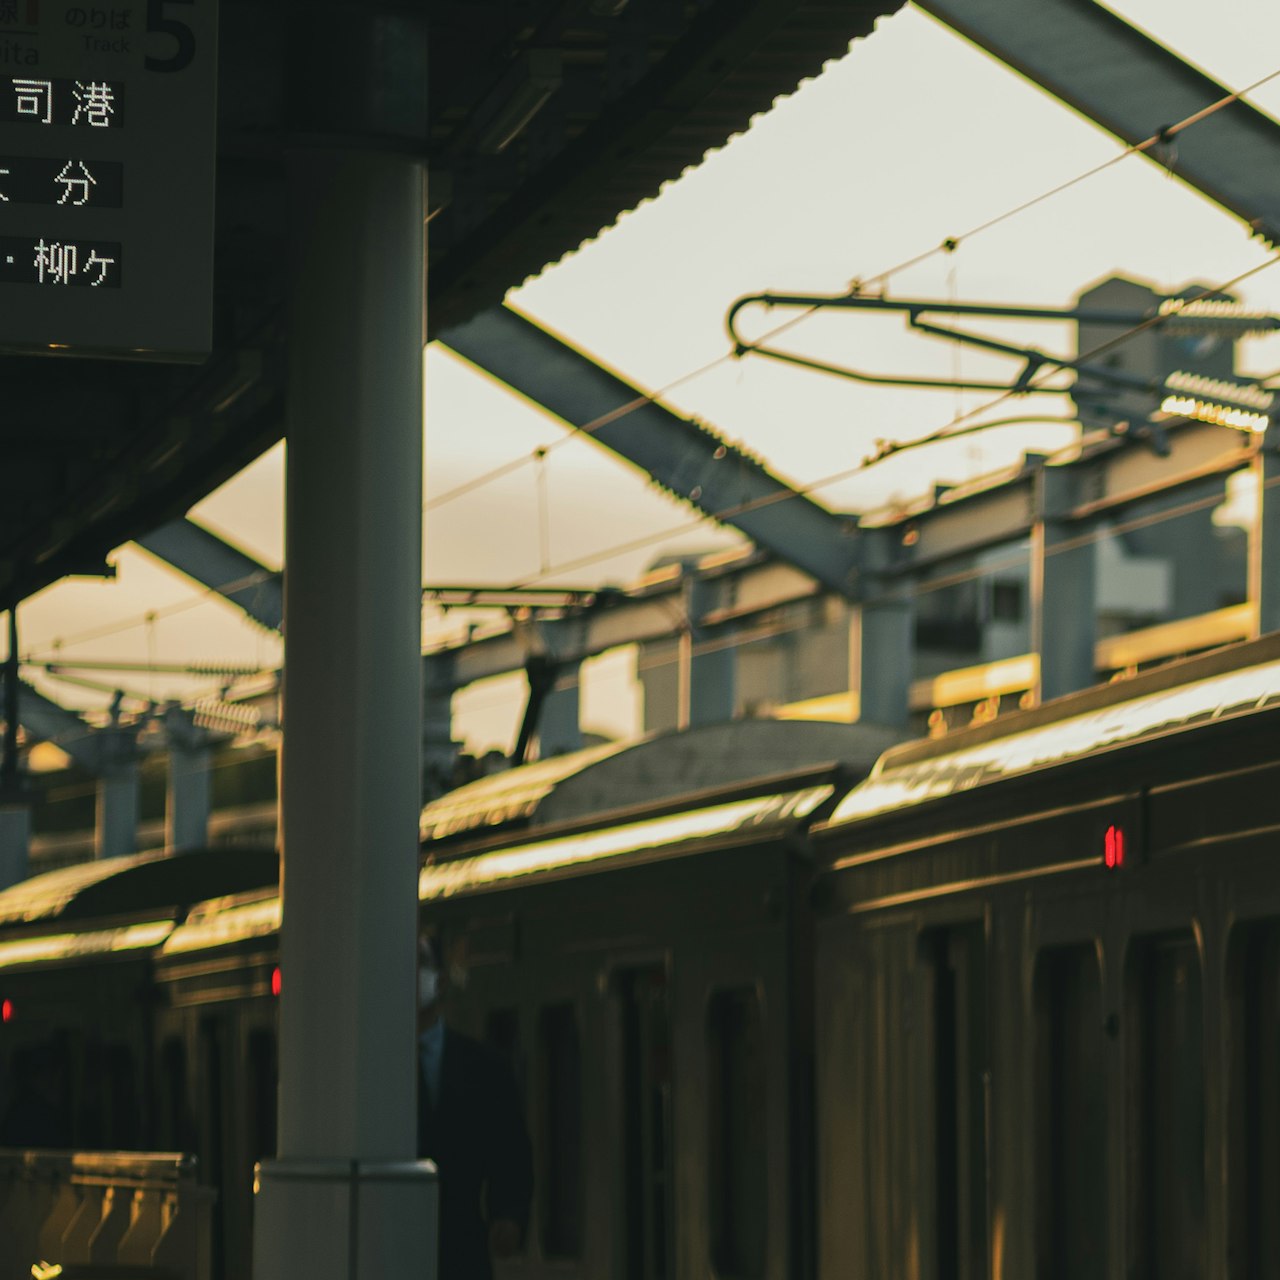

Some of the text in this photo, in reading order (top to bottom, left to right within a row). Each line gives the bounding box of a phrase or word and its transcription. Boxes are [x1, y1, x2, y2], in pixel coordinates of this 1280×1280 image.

[65, 7, 132, 30] のりば
[82, 34, 130, 54] Track
[144, 0, 196, 73] 5
[0, 39, 39, 65] ita
